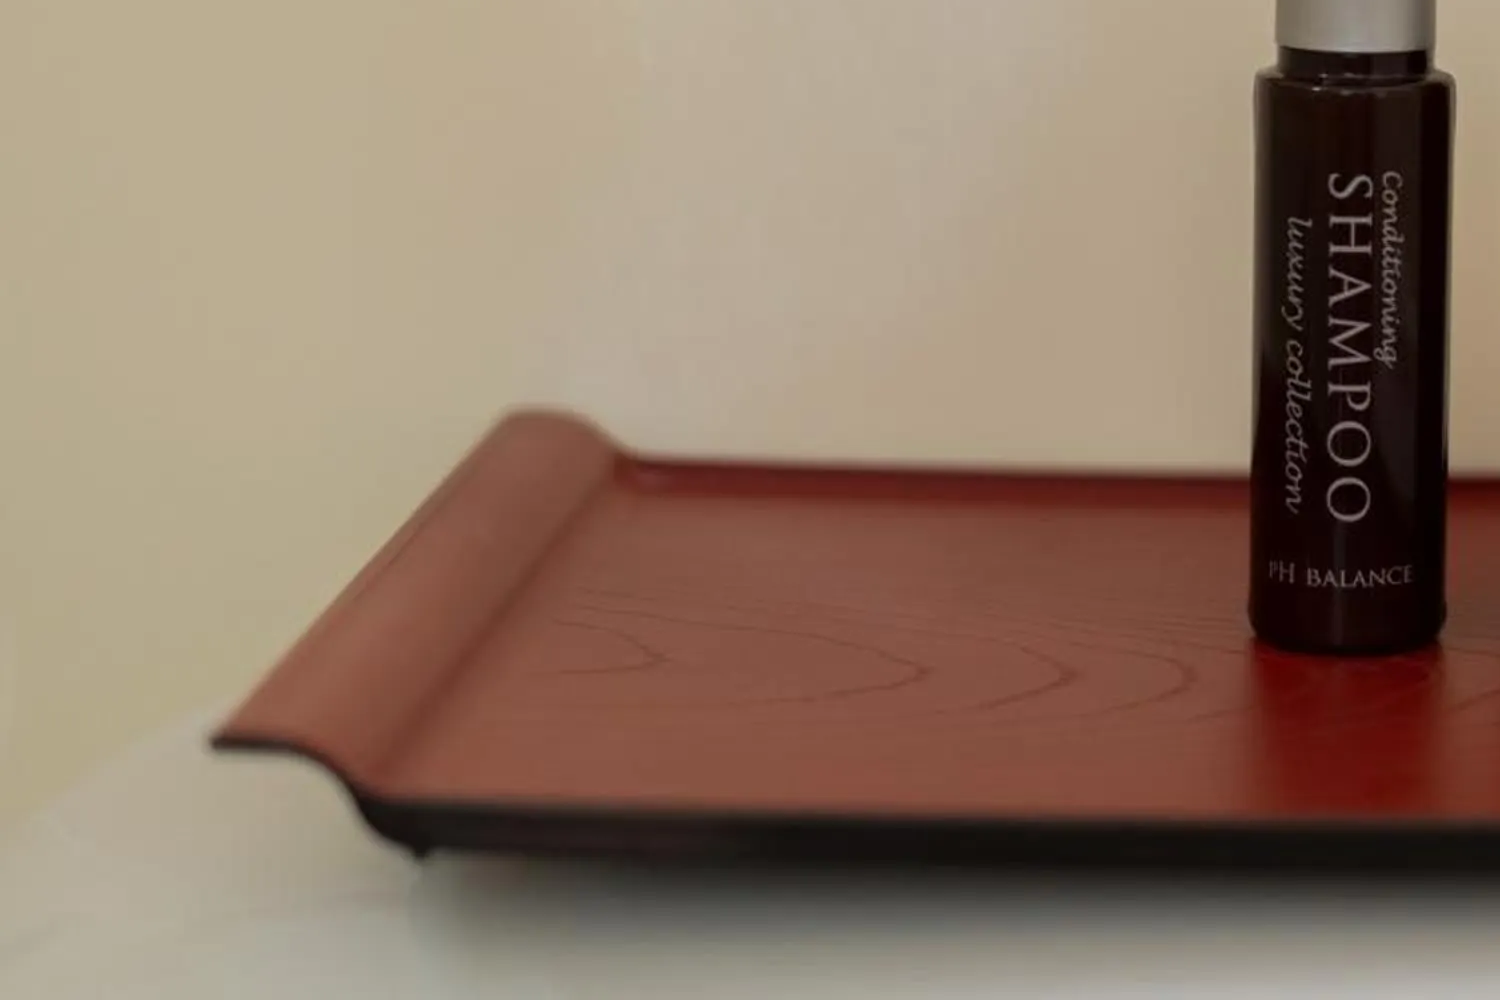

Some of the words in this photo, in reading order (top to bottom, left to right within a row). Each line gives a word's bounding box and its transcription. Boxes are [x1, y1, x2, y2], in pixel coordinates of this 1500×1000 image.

[1281, 216, 1313, 331] luxury
[1326, 172, 1374, 522] SHAMPOO
[1374, 170, 1404, 369] Conditioning
[1284, 340, 1312, 515] collection
[1305, 564, 1415, 589] BALANCE
